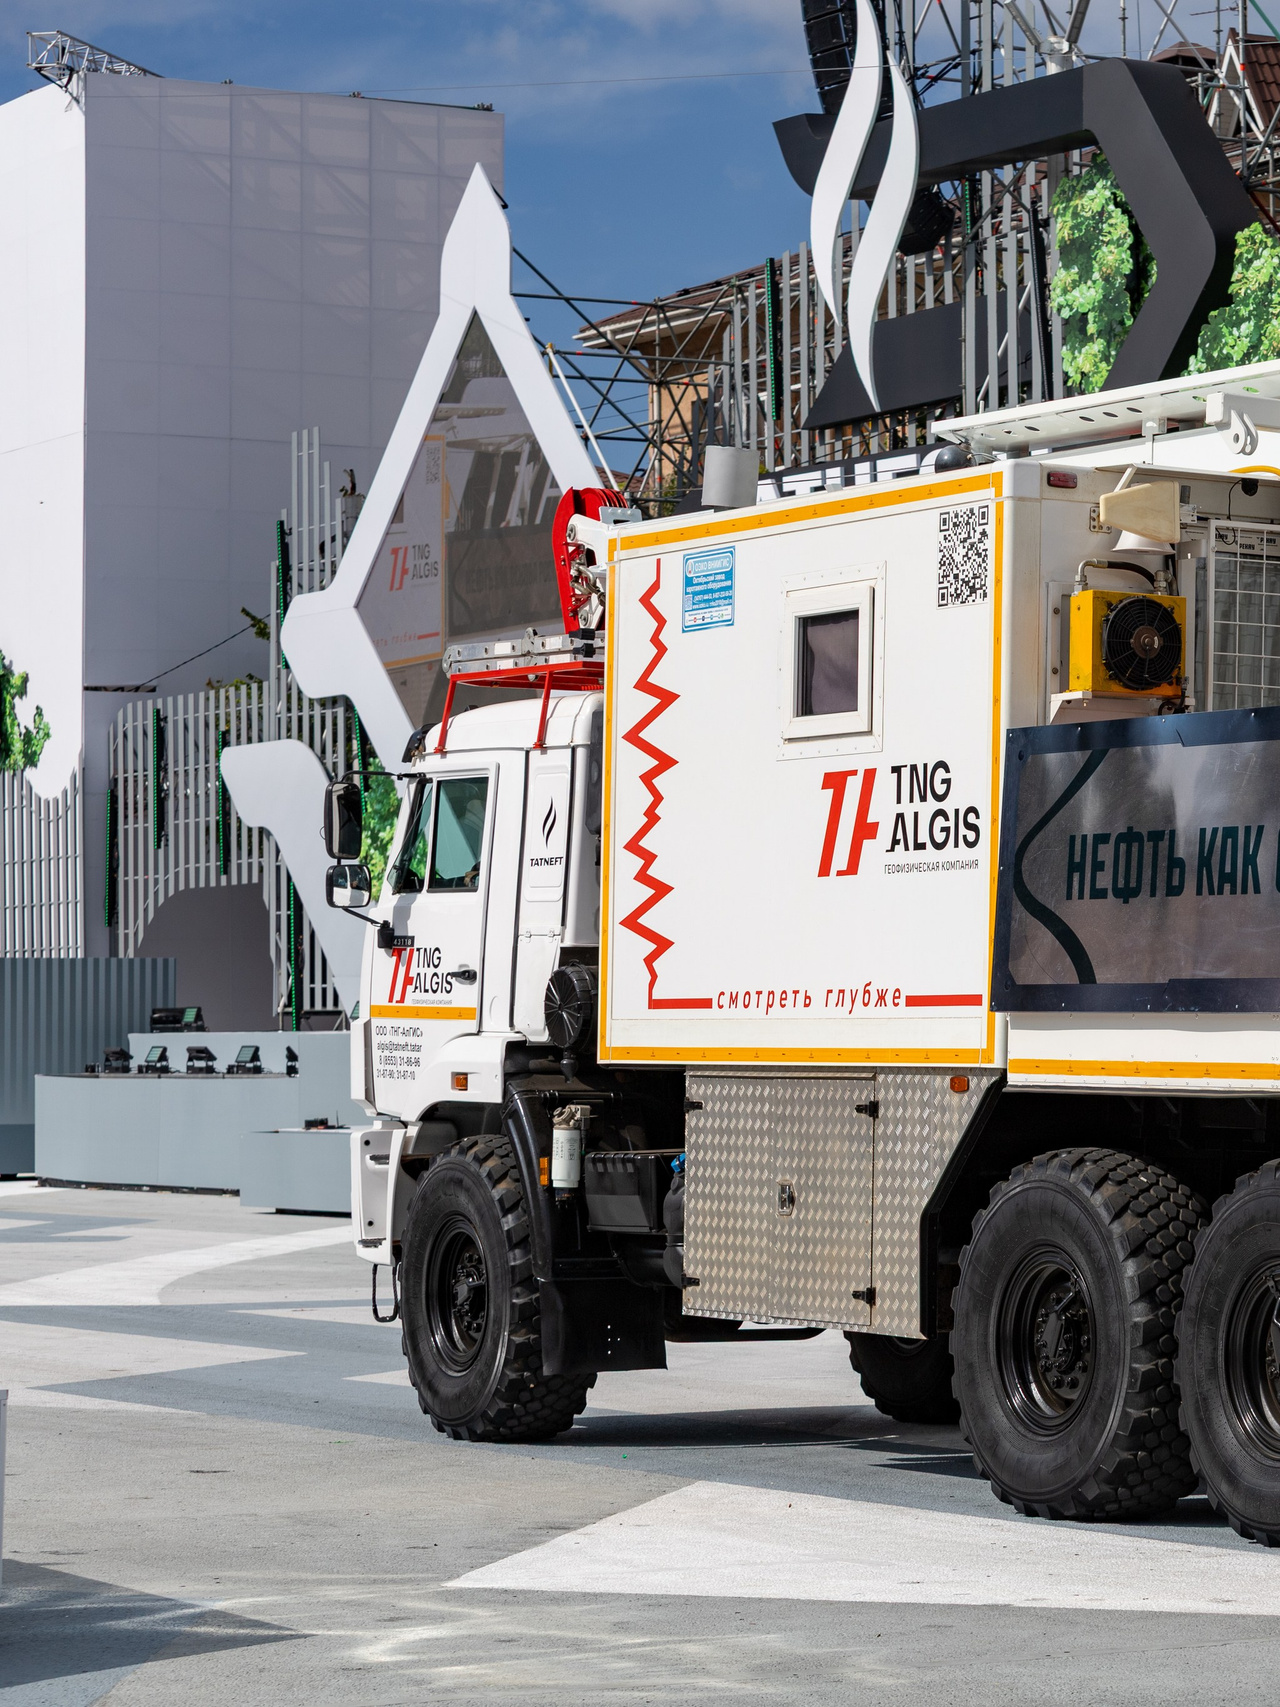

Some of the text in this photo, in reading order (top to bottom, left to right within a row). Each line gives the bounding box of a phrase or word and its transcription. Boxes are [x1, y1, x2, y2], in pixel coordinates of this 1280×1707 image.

[412, 543, 430, 561] TNG
[411, 561, 439, 580] ALGIS
[890, 760, 952, 804] TNG
[885, 806, 980, 853] ALGIS
[530, 856, 564, 867] TATNEFT
[884, 859, 979, 875] ГЕОФИЗИЧЕСКАЯ КОМПАНИЯ
[1065, 826, 1186, 904] НЕФТЬ
[1196, 824, 1265, 896] КАК
[416, 947, 442, 969] TNG
[412, 971, 453, 994] ALGIS
[717, 981, 901, 1015] смотреть глубже
